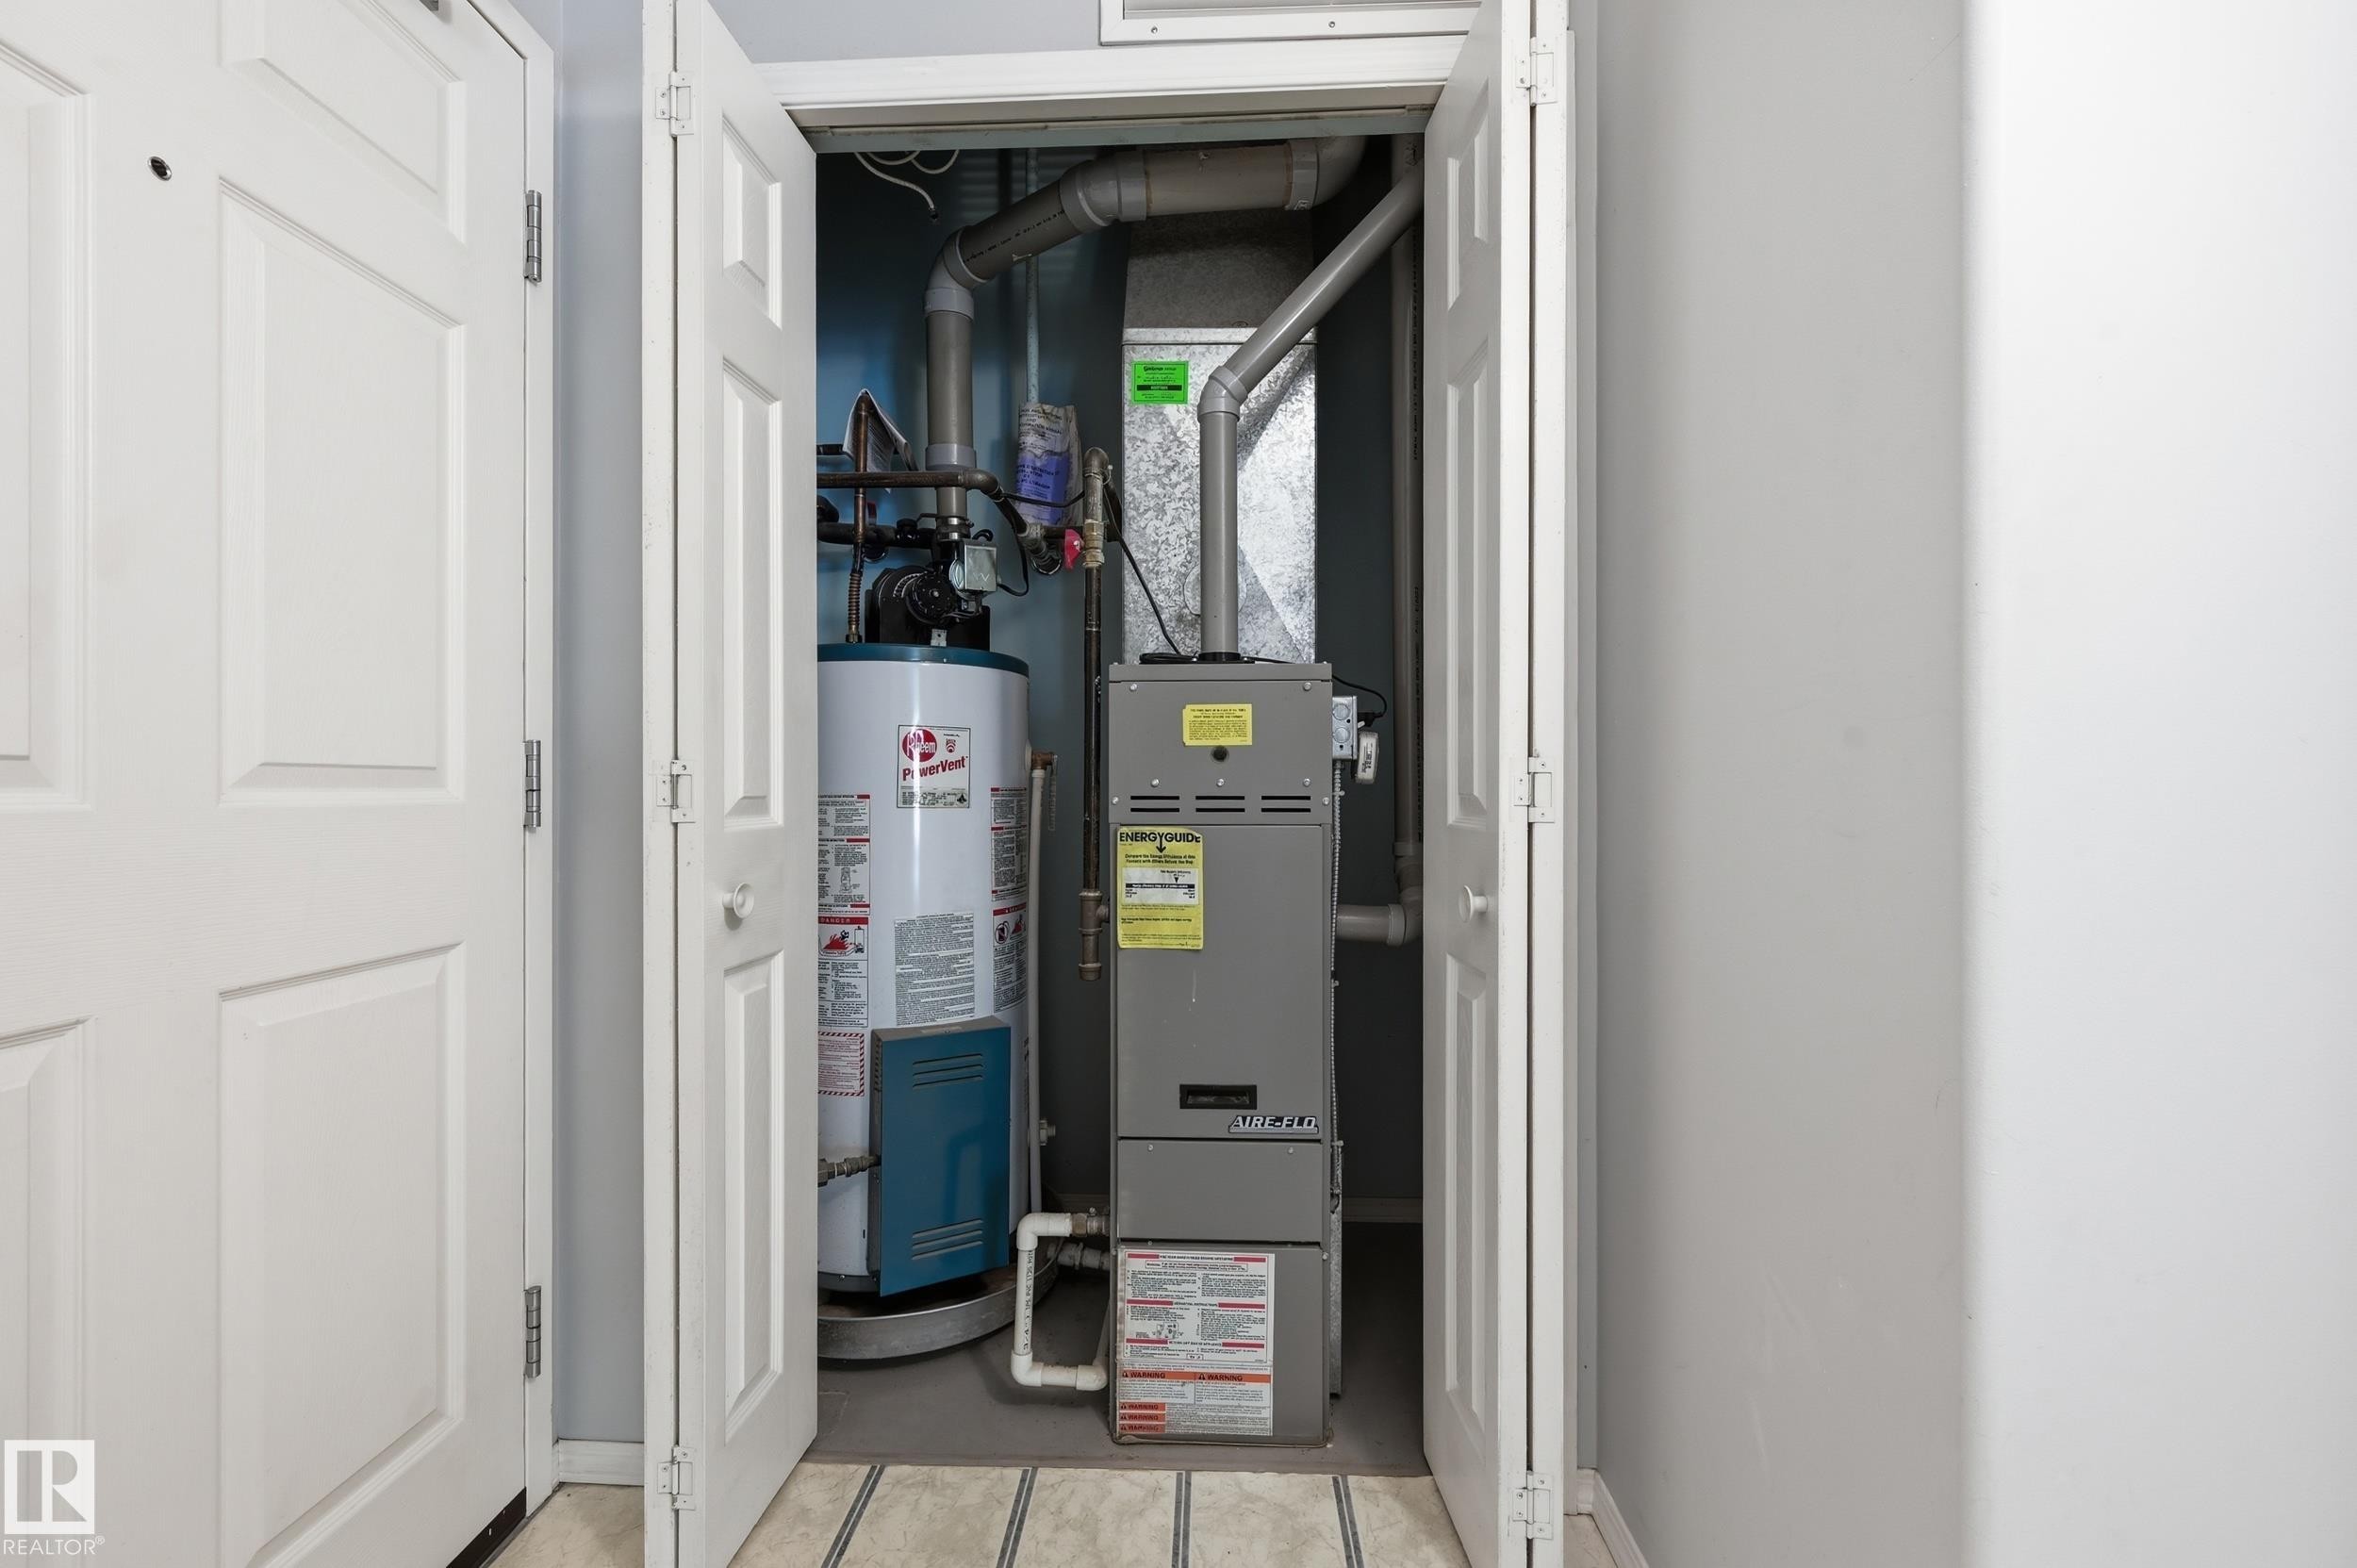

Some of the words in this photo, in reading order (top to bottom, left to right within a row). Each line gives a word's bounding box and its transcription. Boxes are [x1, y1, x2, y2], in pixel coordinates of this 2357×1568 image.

[902, 756, 965, 782] PwerVent
[1119, 832, 1201, 843] ENERGYGUIDE
[1229, 1115, 1317, 1130] AIRE-FLO
[1130, 1371, 1165, 1379] WARNING
[1207, 1373, 1243, 1382] WARNING
[1128, 1423, 1159, 1431] WARNING
